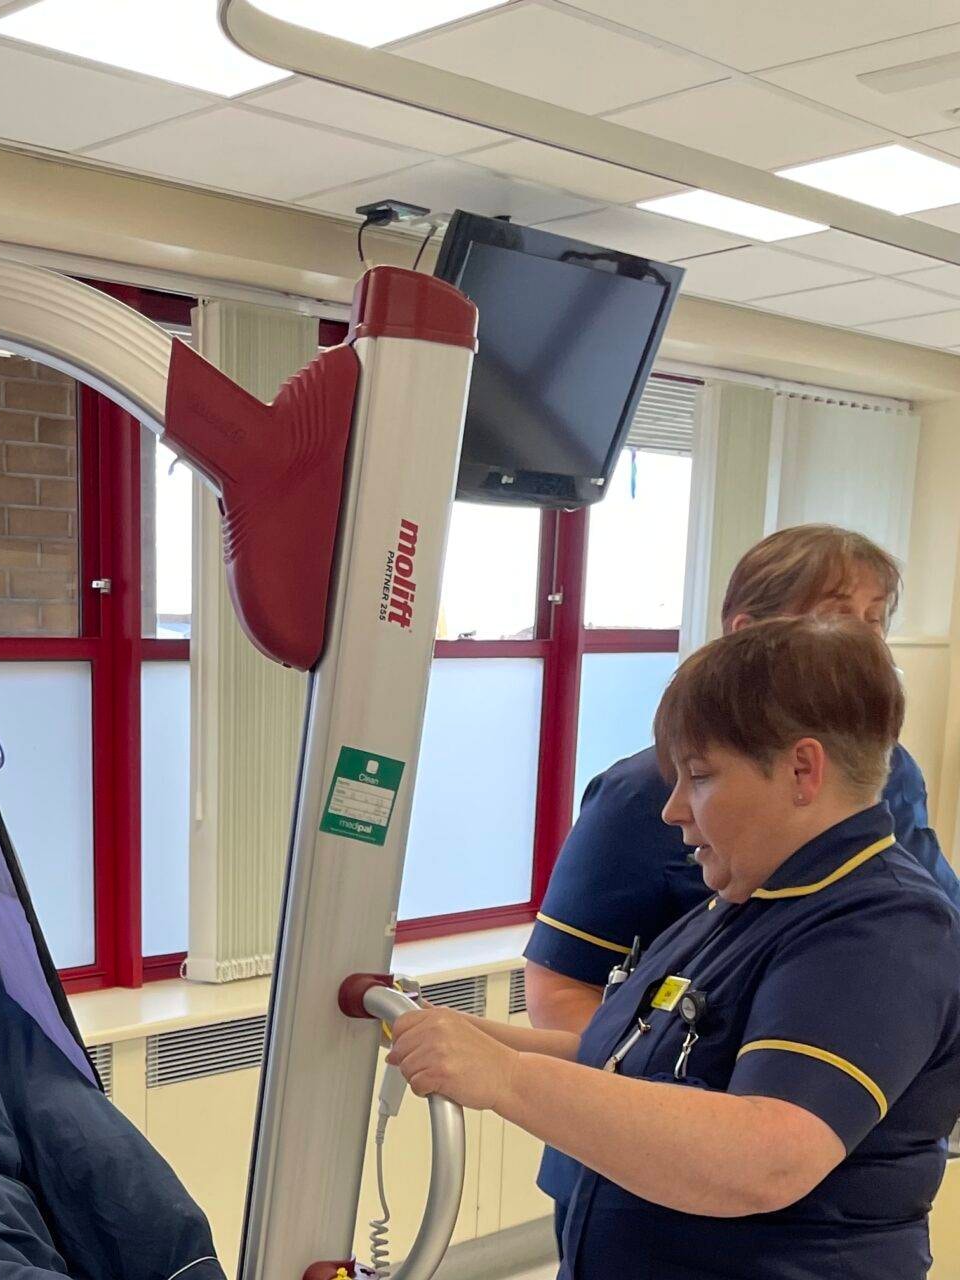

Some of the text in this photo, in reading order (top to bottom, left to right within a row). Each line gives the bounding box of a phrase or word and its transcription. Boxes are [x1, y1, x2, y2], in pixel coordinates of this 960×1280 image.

[379, 550, 394, 621] PARTNER 255
[387, 518, 419, 629] molift
